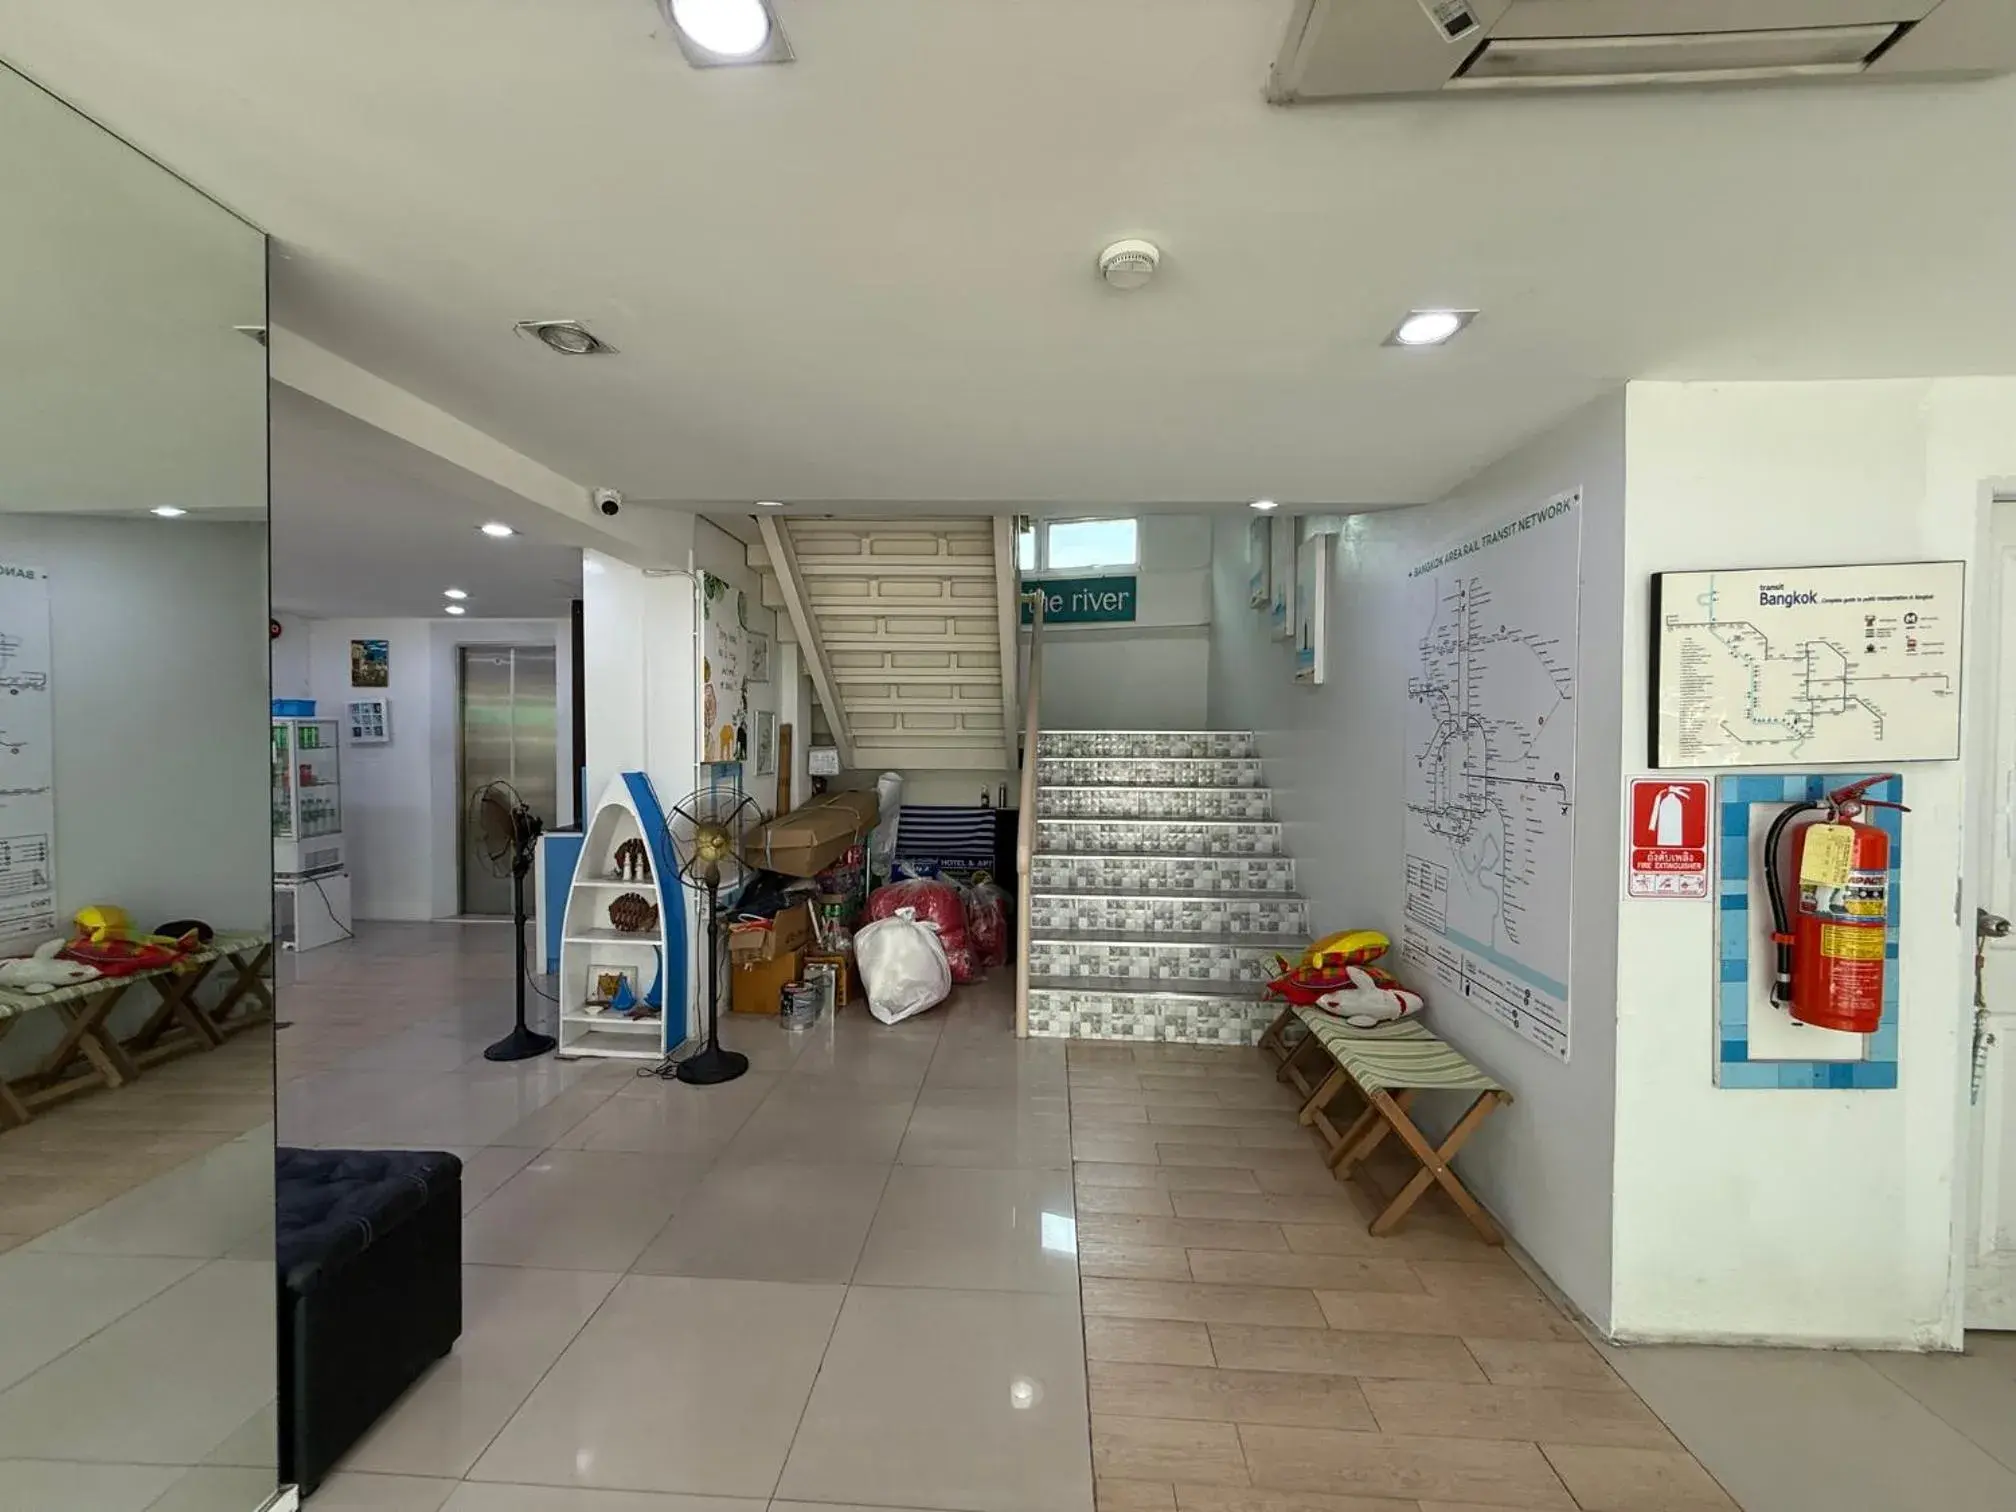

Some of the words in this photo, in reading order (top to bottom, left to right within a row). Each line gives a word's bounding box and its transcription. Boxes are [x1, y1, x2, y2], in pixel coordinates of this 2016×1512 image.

[1413, 555, 1444, 577] BANGKOK
[1444, 547, 1463, 566] AREA
[1463, 539, 1480, 556] RAIL
[1481, 521, 1518, 548] TRANSIT
[1517, 498, 1571, 532] NETWORK
[1759, 582, 1785, 591] transit
[1072, 588, 1130, 612] river
[1760, 589, 1818, 608] Bangkok
[1637, 861, 1652, 869] FIRE
[1654, 861, 1702, 870] EXTINGUISHER
